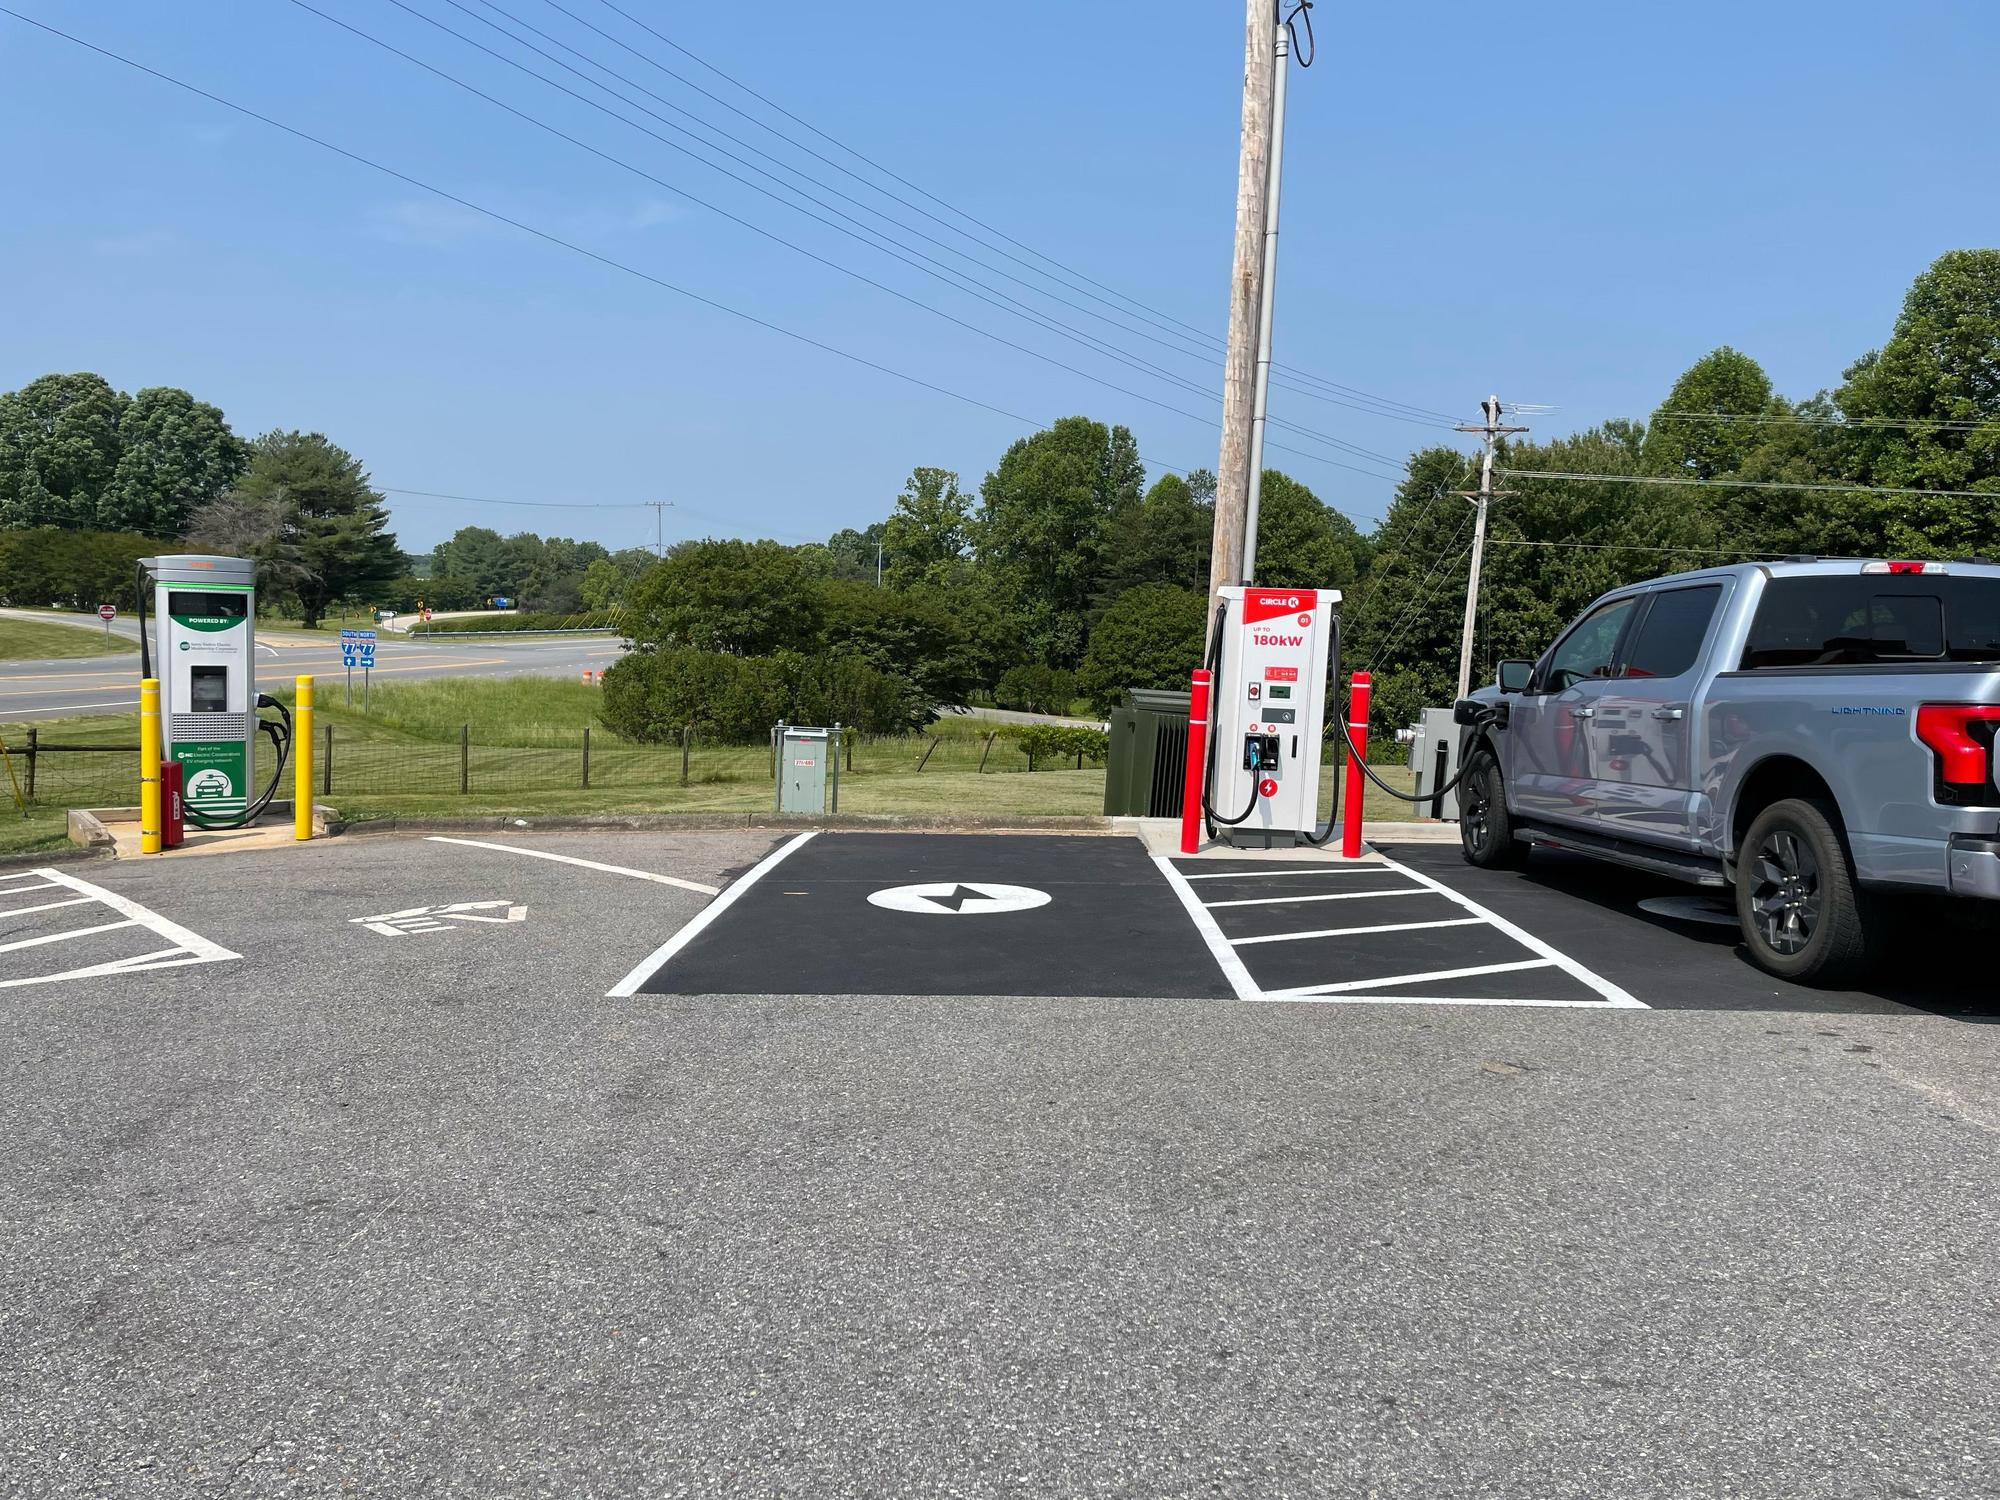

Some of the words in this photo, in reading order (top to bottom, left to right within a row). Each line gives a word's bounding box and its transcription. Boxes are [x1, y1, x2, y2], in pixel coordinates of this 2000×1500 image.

[1260, 598, 1287, 606] CIRCLE
[1289, 598, 1298, 607] K
[1253, 635, 1303, 647] 180kW
[343, 643, 355, 653] 77
[361, 644, 374, 653] 77
[1831, 707, 1906, 715] LIGHTNING
